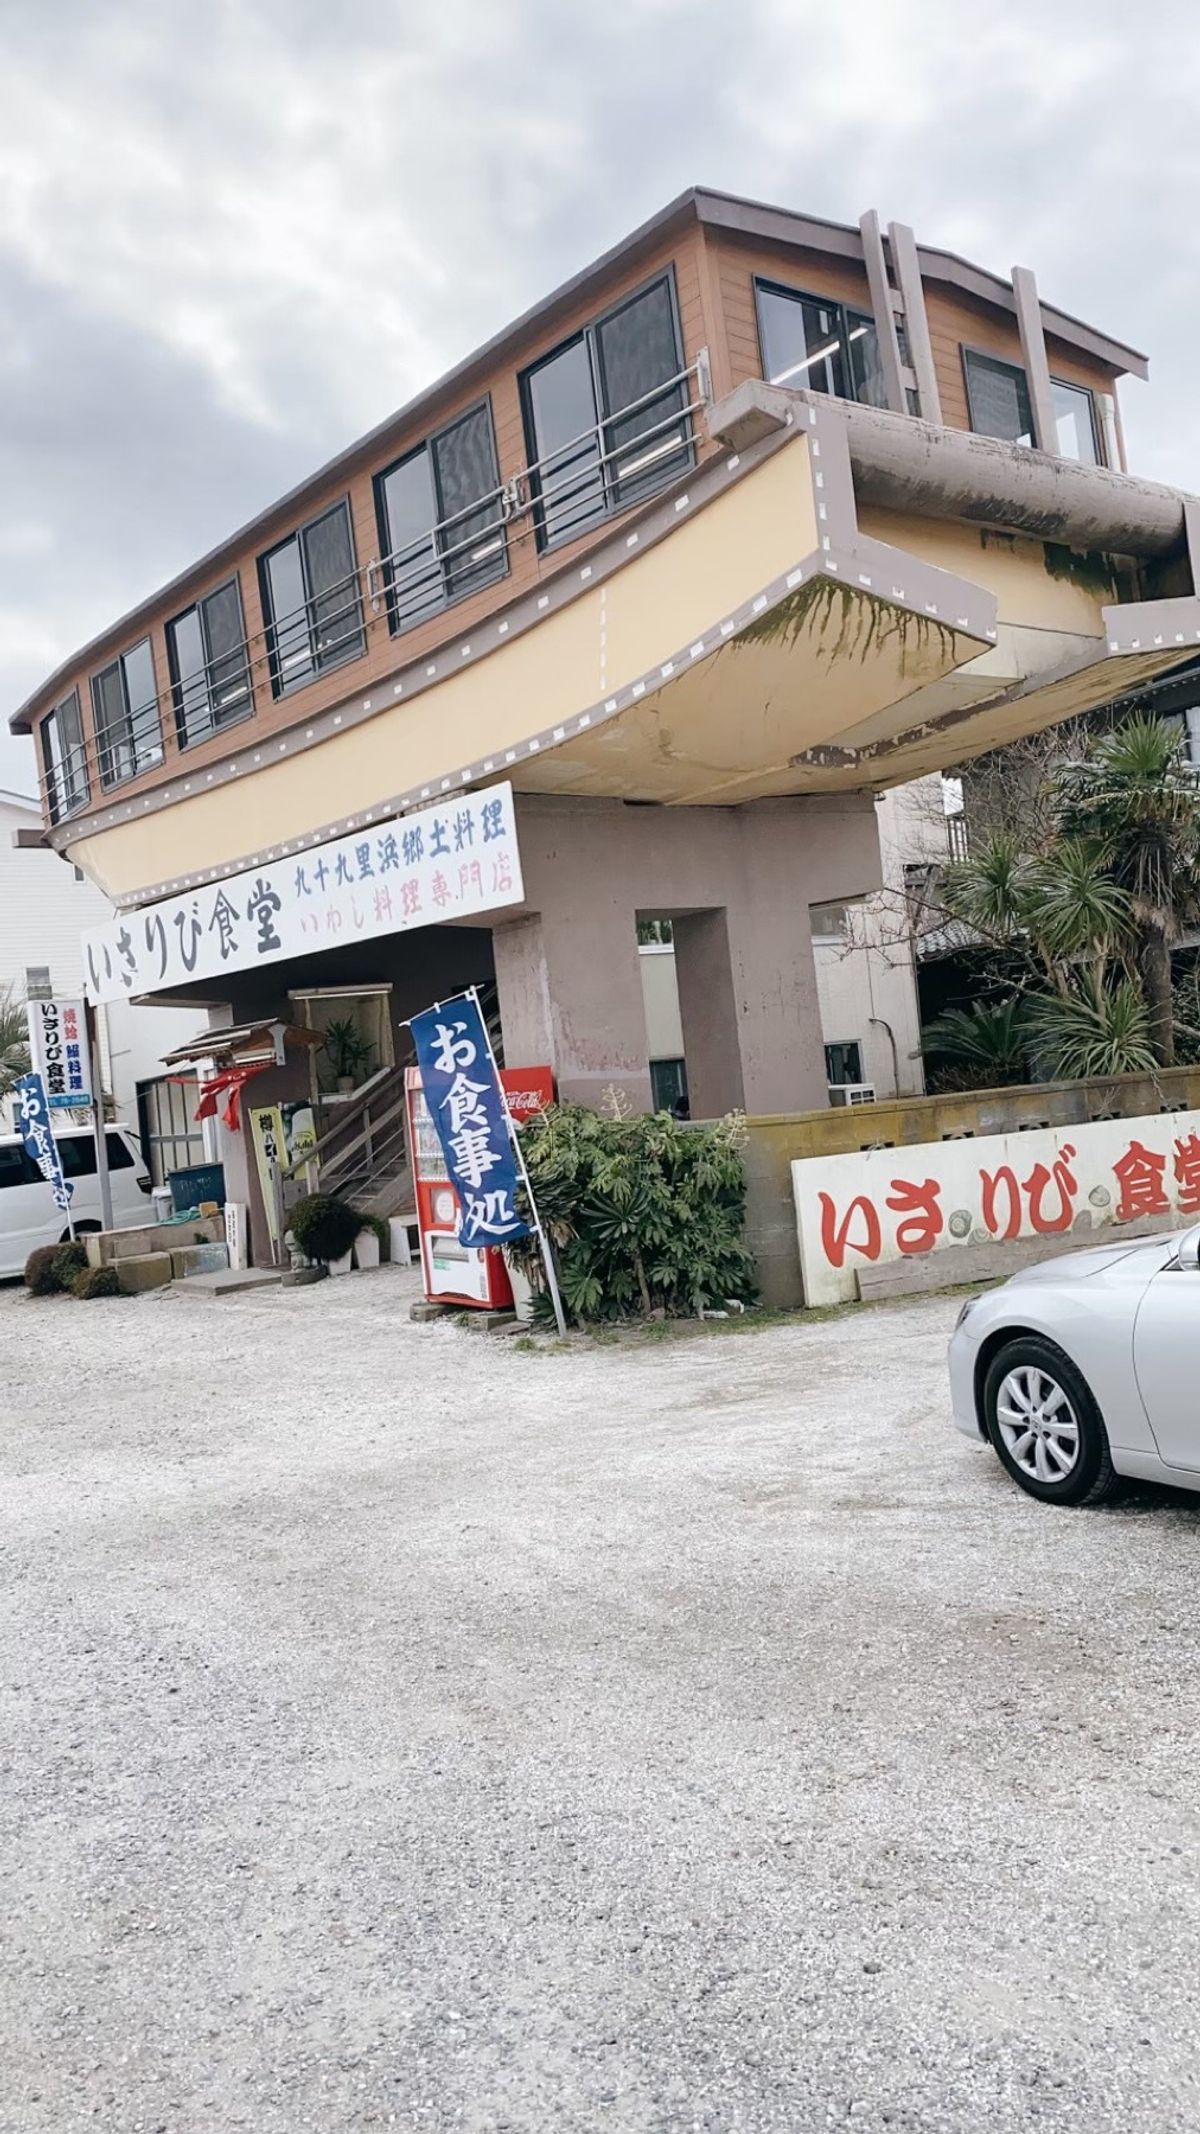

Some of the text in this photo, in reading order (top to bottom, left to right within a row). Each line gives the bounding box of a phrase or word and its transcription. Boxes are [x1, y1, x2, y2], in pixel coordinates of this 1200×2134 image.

[294, 799, 507, 898] 九十九里浜郷土料理
[300, 851, 513, 934] いわし料理専門店
[87, 877, 282, 994] いさりび食堂
[41, 1003, 66, 1095] いさりび食堂
[430, 1021, 521, 1241] お食事処
